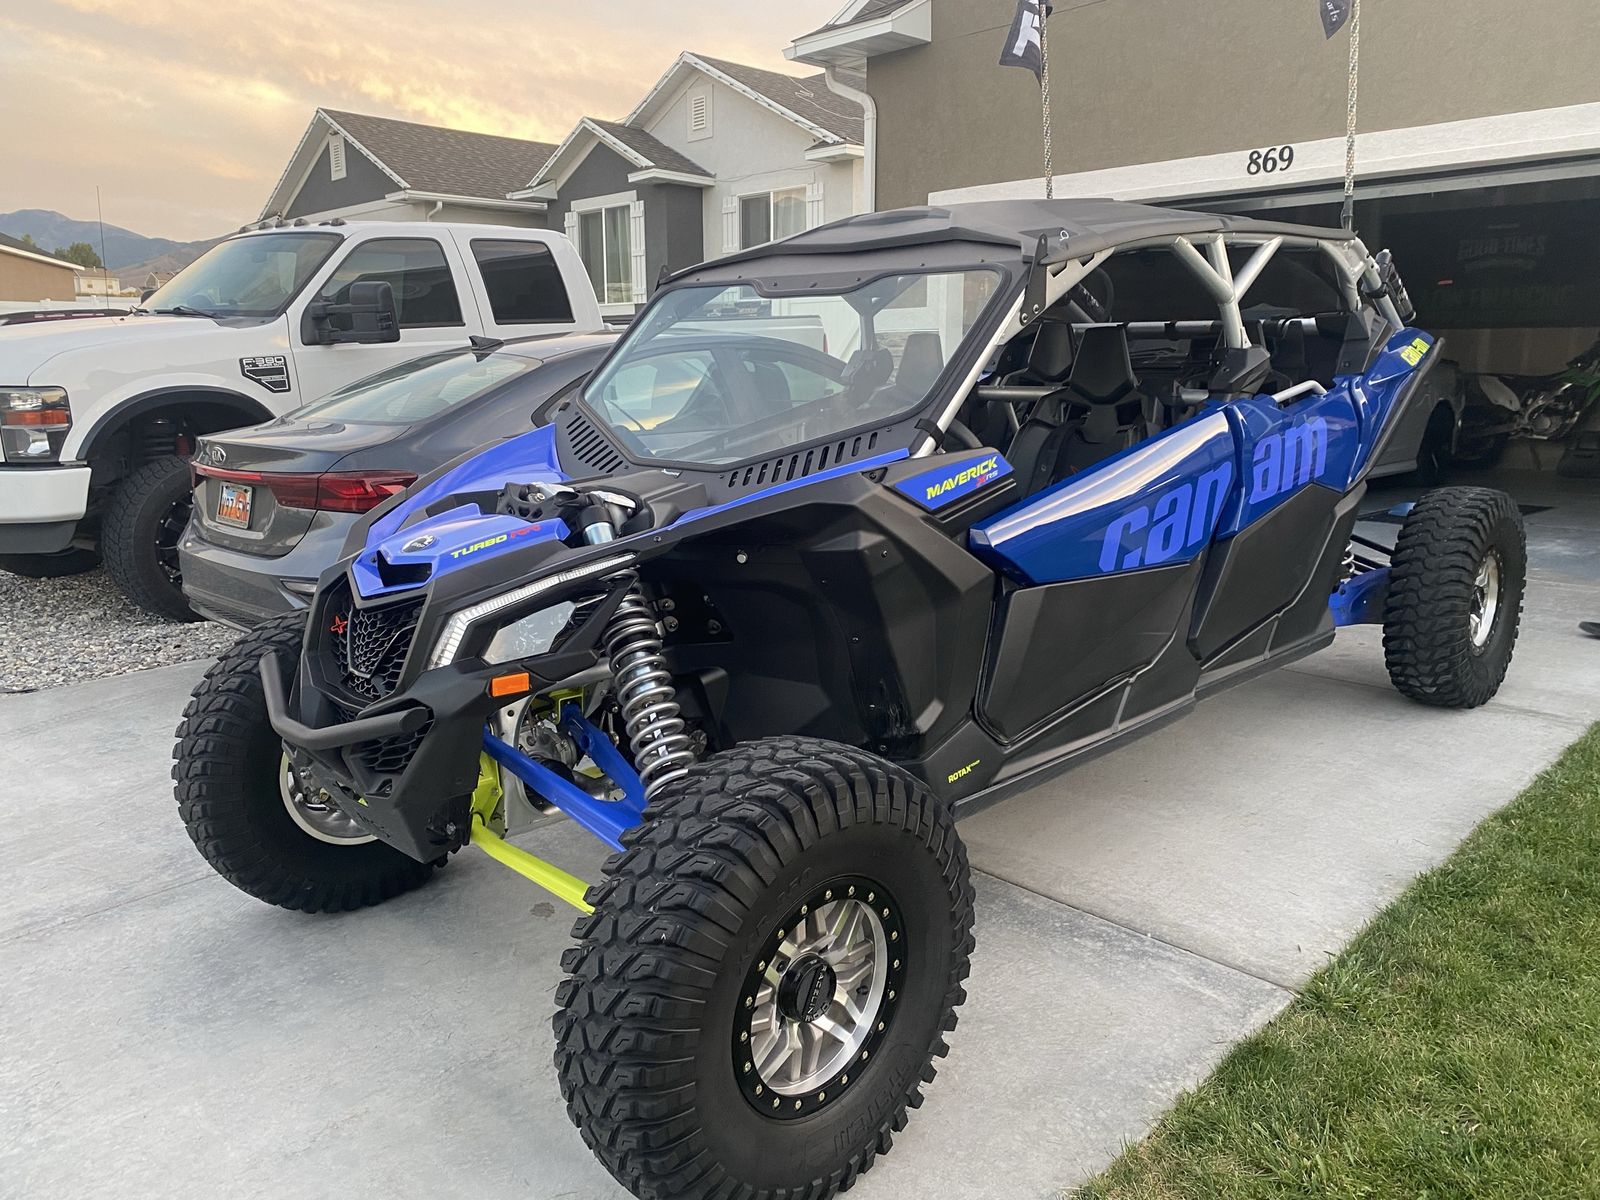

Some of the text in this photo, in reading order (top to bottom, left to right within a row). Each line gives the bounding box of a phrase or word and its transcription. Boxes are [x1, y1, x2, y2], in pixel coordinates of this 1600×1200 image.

[1247, 145, 1294, 175] 869
[926, 455, 998, 500] MAVERICK
[450, 534, 508, 559] TURBO
[947, 764, 972, 784] ROTAX
